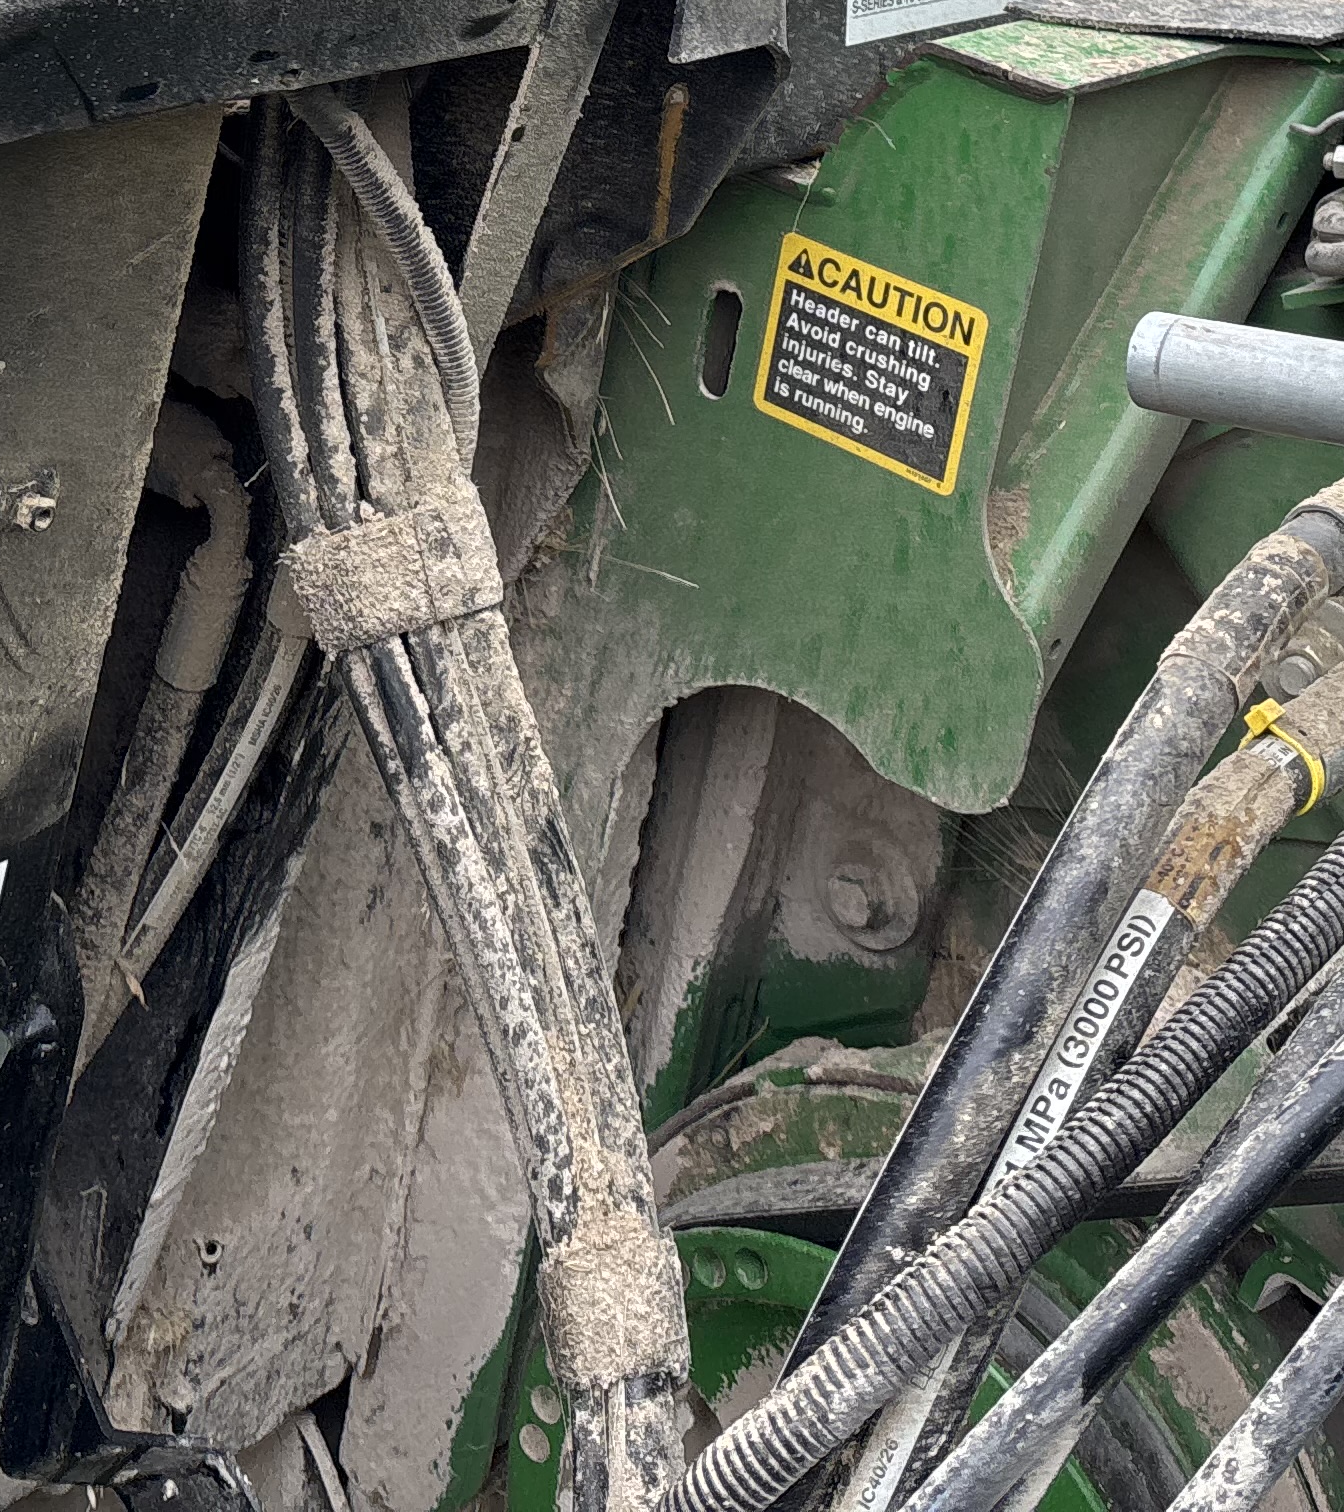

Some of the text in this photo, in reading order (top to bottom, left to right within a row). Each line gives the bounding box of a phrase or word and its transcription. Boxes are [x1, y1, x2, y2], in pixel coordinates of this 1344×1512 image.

[790, 289, 940, 368] Header can tilt.
[818, 257, 976, 346] CAUTION
[782, 333, 909, 405] injuries. Stay
[786, 312, 931, 391] Avoid crushing
[774, 376, 868, 434] is running.
[778, 359, 934, 438] clear when engine
[246, 716, 268, 747] MSHA
[1015, 1076, 1069, 1154] MPa
[1057, 979, 1119, 1069] (3000
[1105, 914, 1157, 979] PSI)
[857, 1438, 899, 1510] IC40/26
